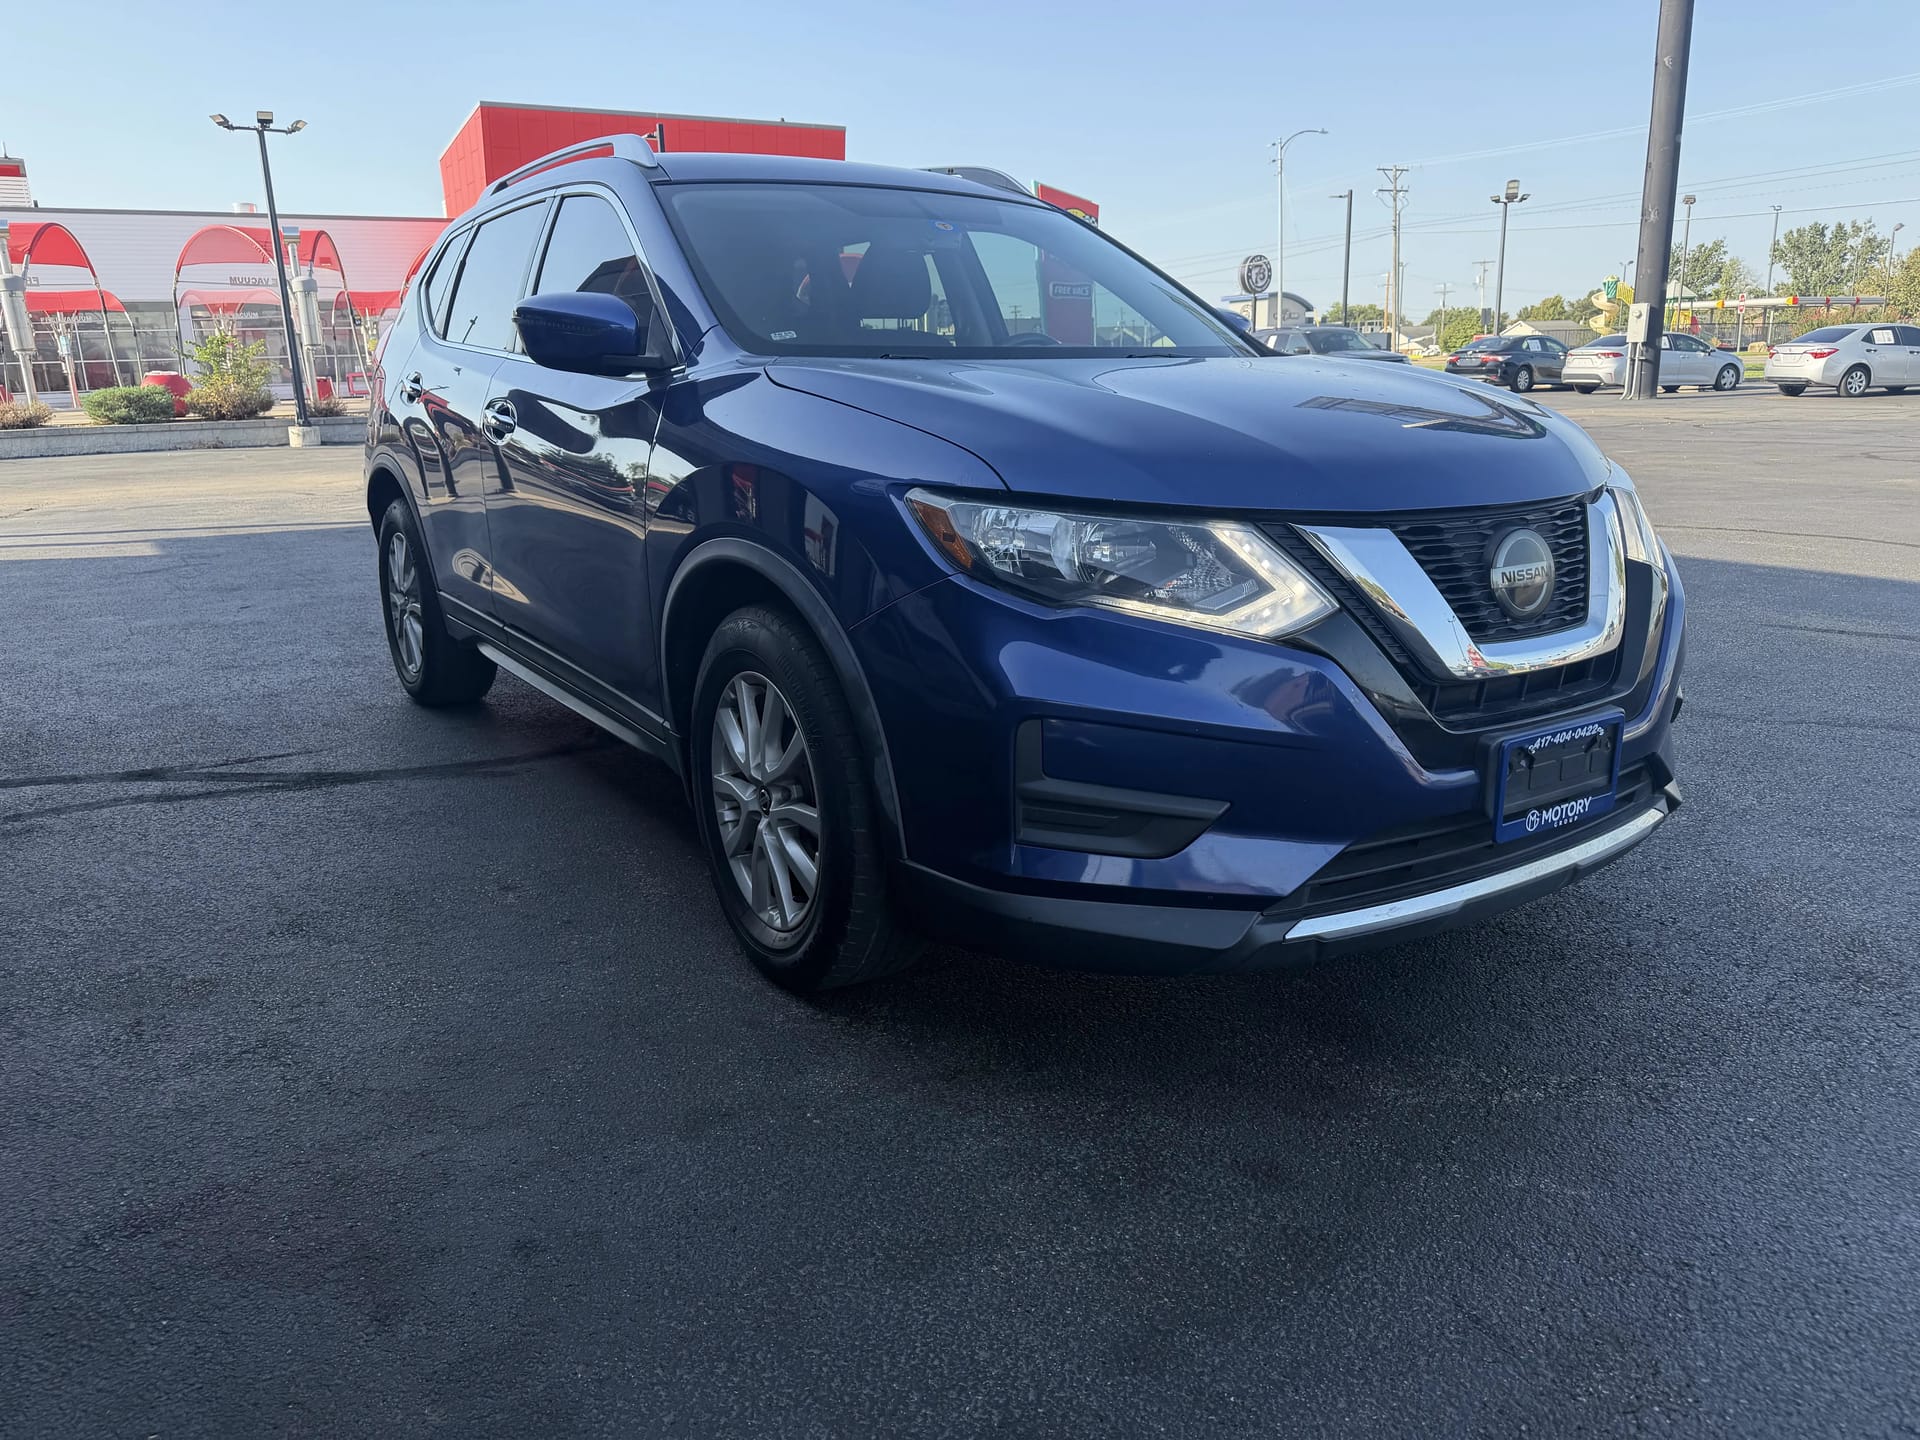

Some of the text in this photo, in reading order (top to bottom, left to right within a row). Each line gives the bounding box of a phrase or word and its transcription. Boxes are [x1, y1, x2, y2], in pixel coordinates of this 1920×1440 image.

[1501, 565, 1548, 584] NISSAN
[1541, 796, 1593, 825] MOTORY
[1553, 815, 1579, 828] GROUP
